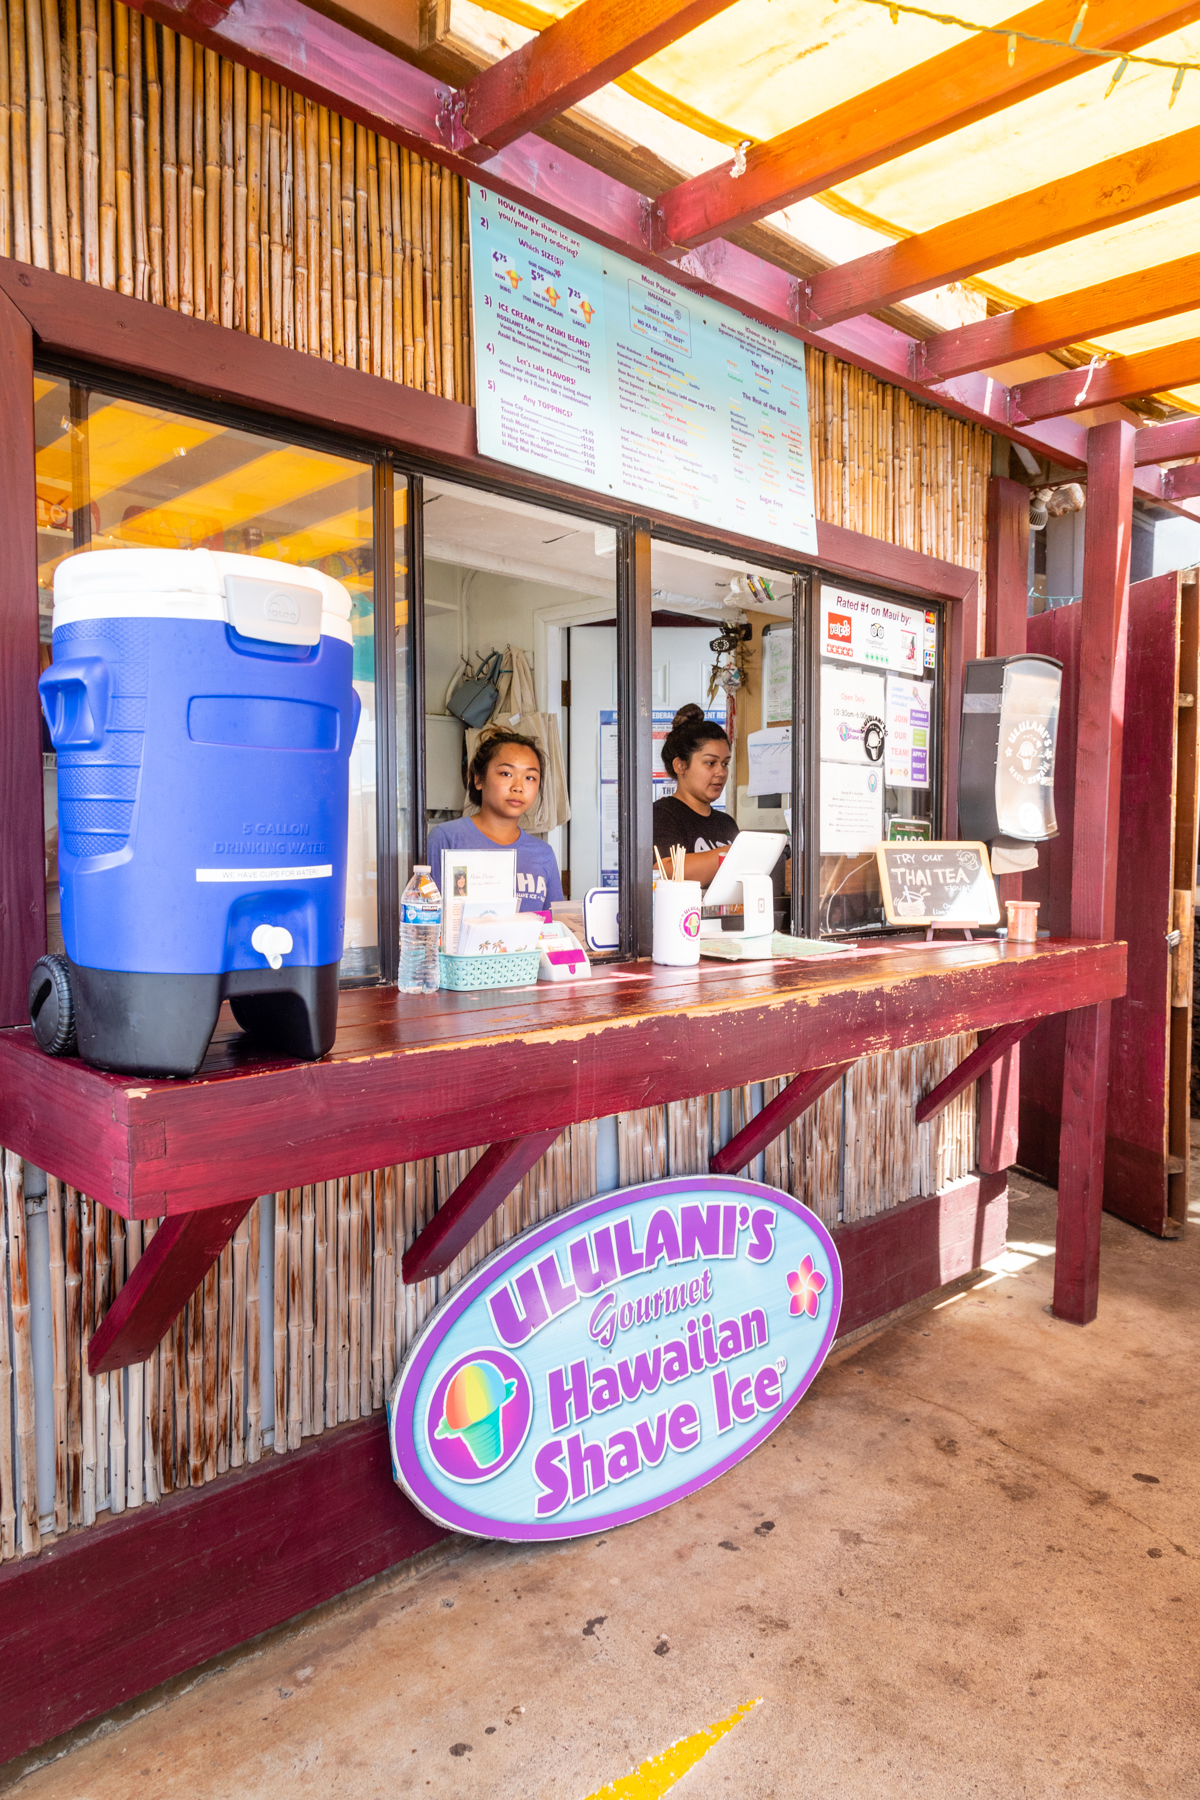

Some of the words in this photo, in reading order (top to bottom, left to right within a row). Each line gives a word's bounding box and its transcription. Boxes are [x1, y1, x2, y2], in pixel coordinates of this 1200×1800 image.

[479, 188, 486, 201] 1)
[497, 198, 516, 212] HOW
[518, 209, 538, 225] MANY
[540, 222, 557, 235] shave
[559, 231, 568, 241] ice
[570, 237, 580, 247] are
[480, 216, 488, 230] 2)
[518, 238, 539, 253] Which
[541, 250, 564, 266] SIZE(S)?
[498, 210, 528, 232] you/your
[530, 227, 547, 242] party
[549, 238, 578, 259] ordering?
[641, 274, 654, 286] Most
[655, 282, 676, 298] Popular
[484, 295, 491, 307] 3)
[498, 302, 509, 312] ICE
[511, 309, 534, 324] CREAM
[546, 324, 565, 337] AZUKI
[567, 334, 590, 348] BEANS?
[525, 326, 544, 338] Gourmet
[486, 341, 494, 354] 4)
[516, 355, 530, 367] Let's
[532, 363, 544, 372] talk
[546, 369, 575, 385] FLAVORS!
[650, 348, 673, 362] Favorites
[750, 359, 759, 369] The
[760, 364, 769, 374] Top
[487, 379, 495, 392] 5)
[522, 394, 535, 406] Any
[537, 400, 572, 417] TOPPINGS?
[741, 392, 751, 401] The
[752, 396, 762, 406] Rest
[777, 407, 786, 416] Best
[650, 427, 664, 438] Local
[672, 435, 688, 446] Exotic
[836, 596, 859, 611] Rated
[861, 602, 869, 613] #1
[871, 607, 880, 616] on
[882, 608, 899, 620] Maui
[901, 613, 911, 626] by:
[830, 624, 843, 636] yelp
[894, 715, 908, 724] JOIN
[894, 731, 906, 740] OUR
[1008, 720, 1052, 747] ULULANI'S
[891, 747, 909, 757] TEAM!
[242, 822, 252, 835] 5
[255, 823, 309, 836] GALLON
[214, 842, 286, 854] DRINKING
[289, 842, 326, 854] WATER
[893, 854, 915, 864] TRY
[891, 868, 932, 886] THAI
[933, 868, 970, 883] TEA
[487, 1202, 776, 1347] ULULANI'S
[588, 1268, 712, 1347] Gourmet
[546, 1307, 768, 1432] Hawaiian
[533, 1401, 700, 1517] Shave
